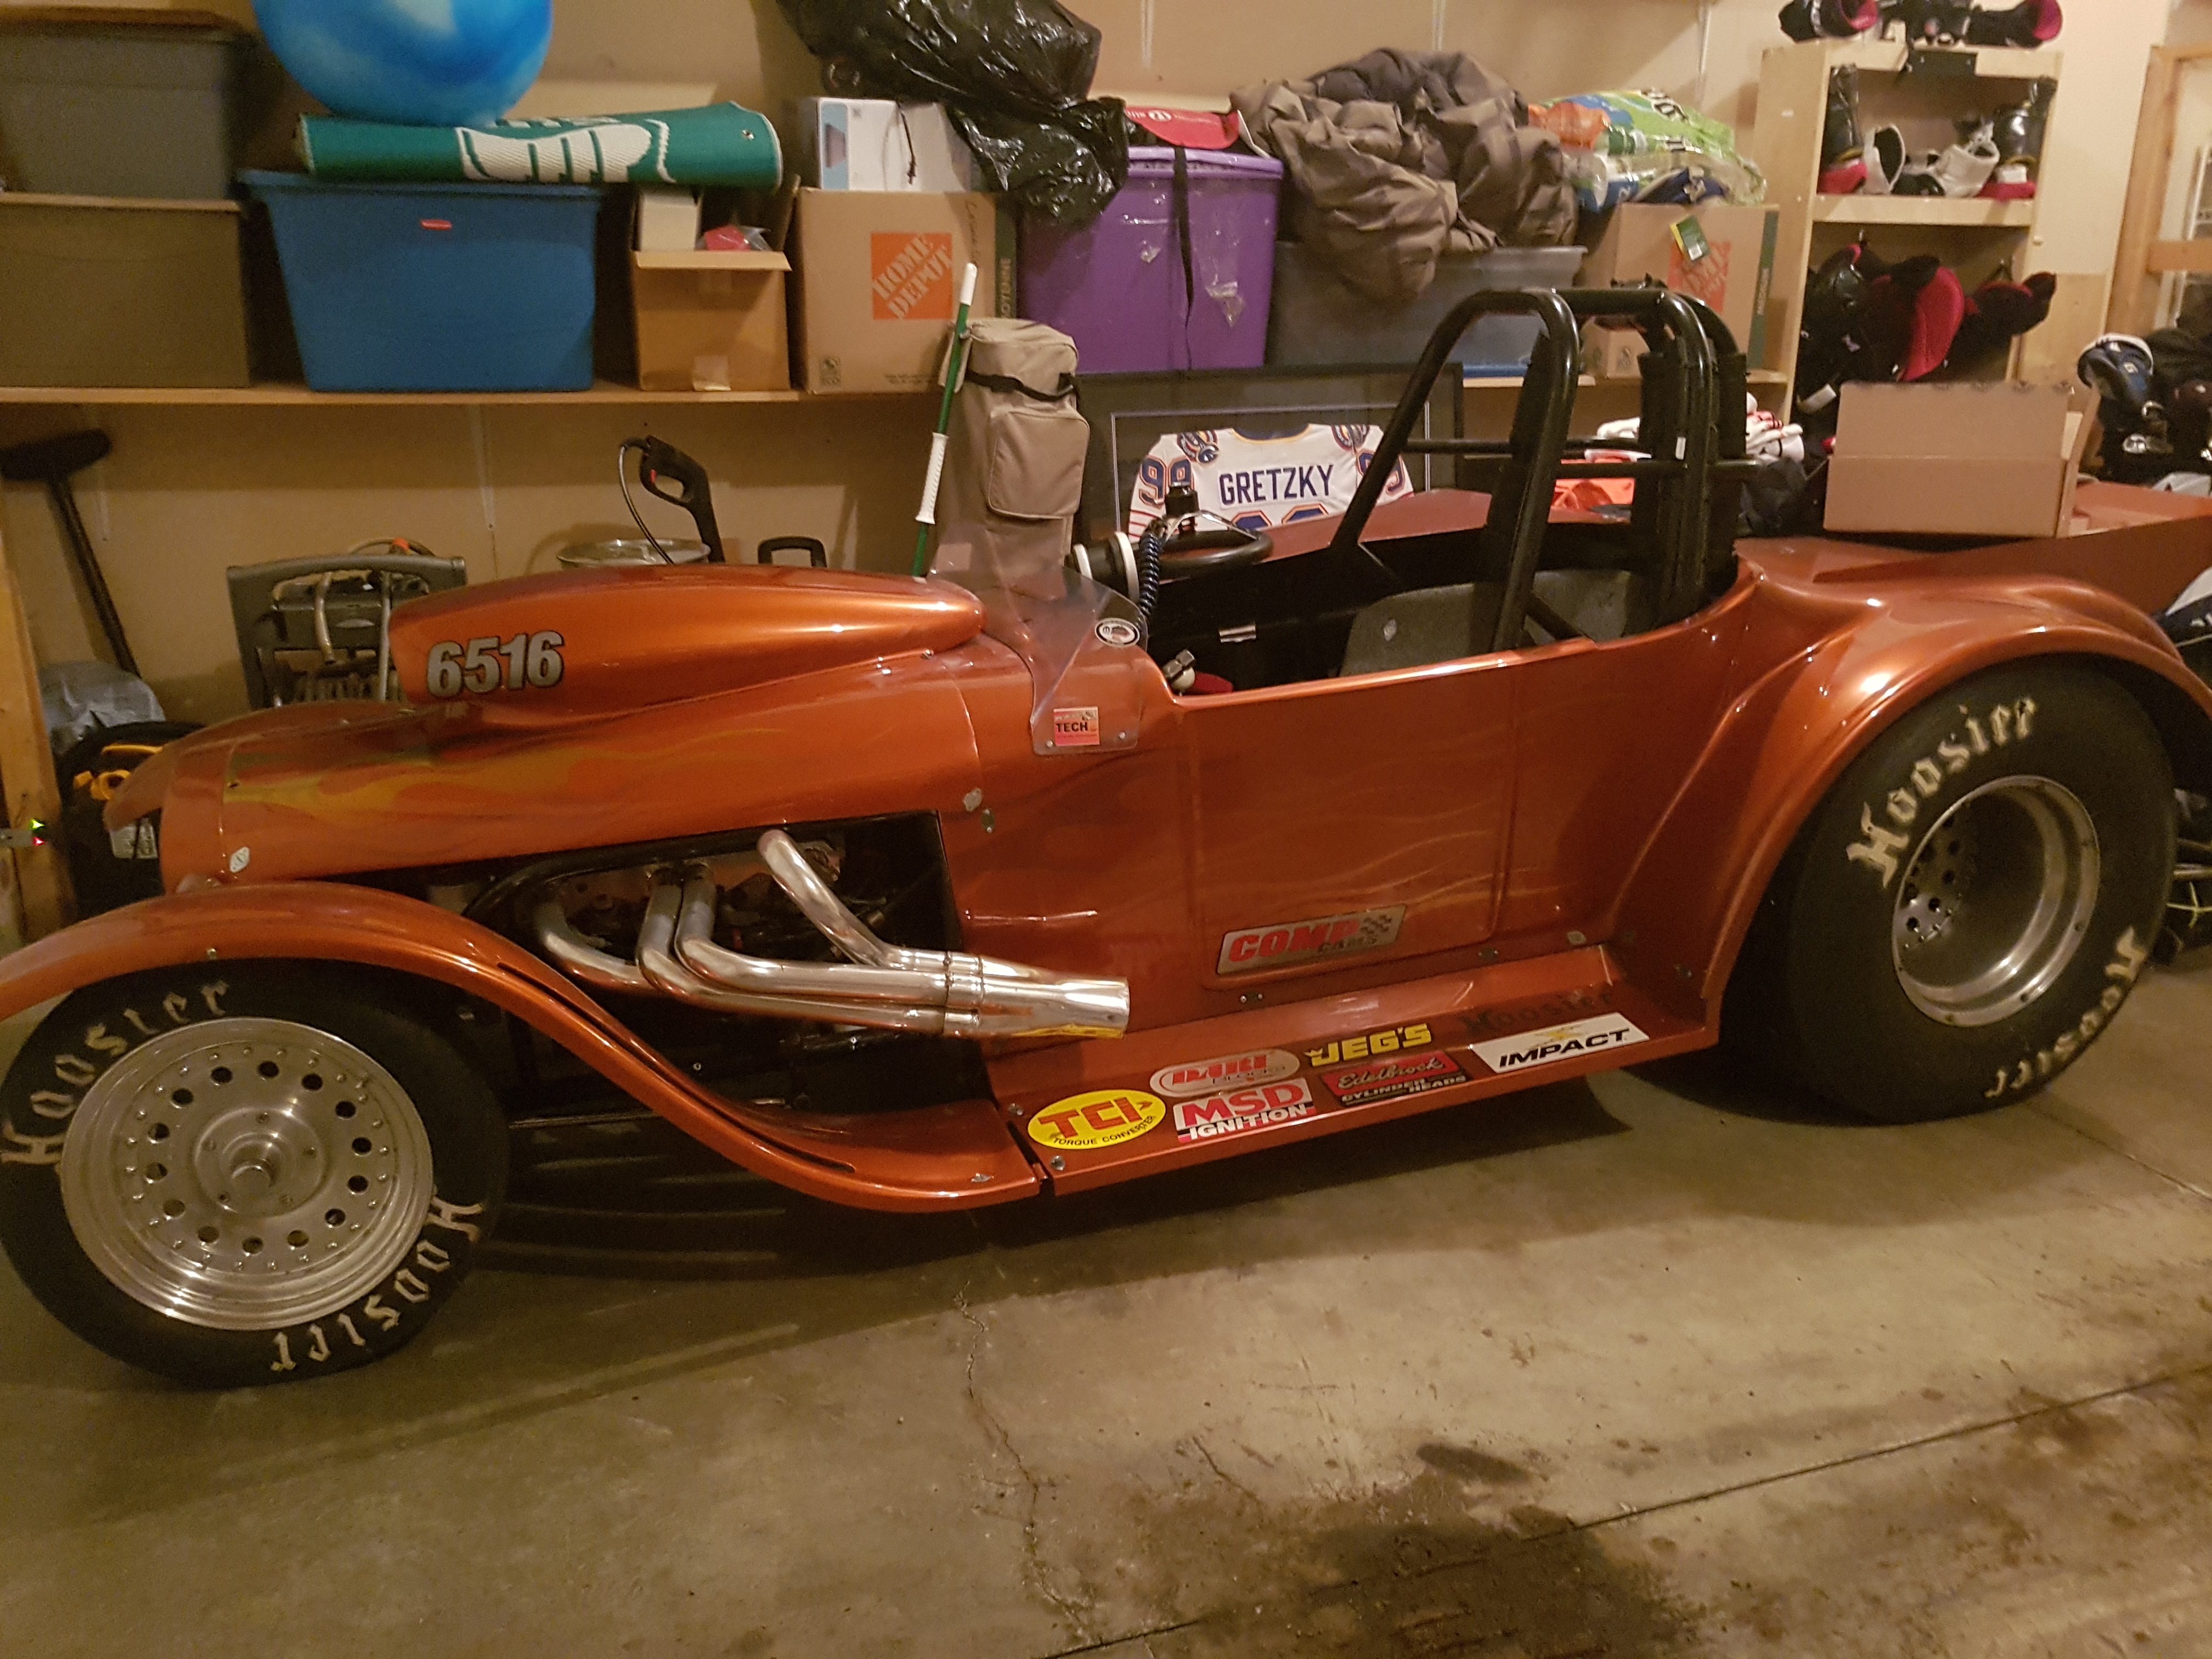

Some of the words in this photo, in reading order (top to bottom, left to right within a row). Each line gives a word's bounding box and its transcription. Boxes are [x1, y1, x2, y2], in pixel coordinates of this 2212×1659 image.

[872, 234, 933, 300] HOME
[887, 245, 952, 319] DEPOT
[1218, 464, 1334, 506] GRETZKY
[427, 630, 565, 698] 6516
[1055, 721, 1088, 732] TECH
[1228, 919, 1361, 963] COMP
[1310, 1023, 1432, 1067] JEG'S
[1499, 1028, 1629, 1068] IMPACT
[1338, 1057, 1445, 1090] Edelbrock
[1341, 1078, 1426, 1102] CYLINDER
[1037, 1097, 1143, 1139] TCI
[1182, 1084, 1305, 1128] MSD
[1189, 1103, 1307, 1140] IGNITION
[1053, 1137, 1097, 1146] TORQUE
